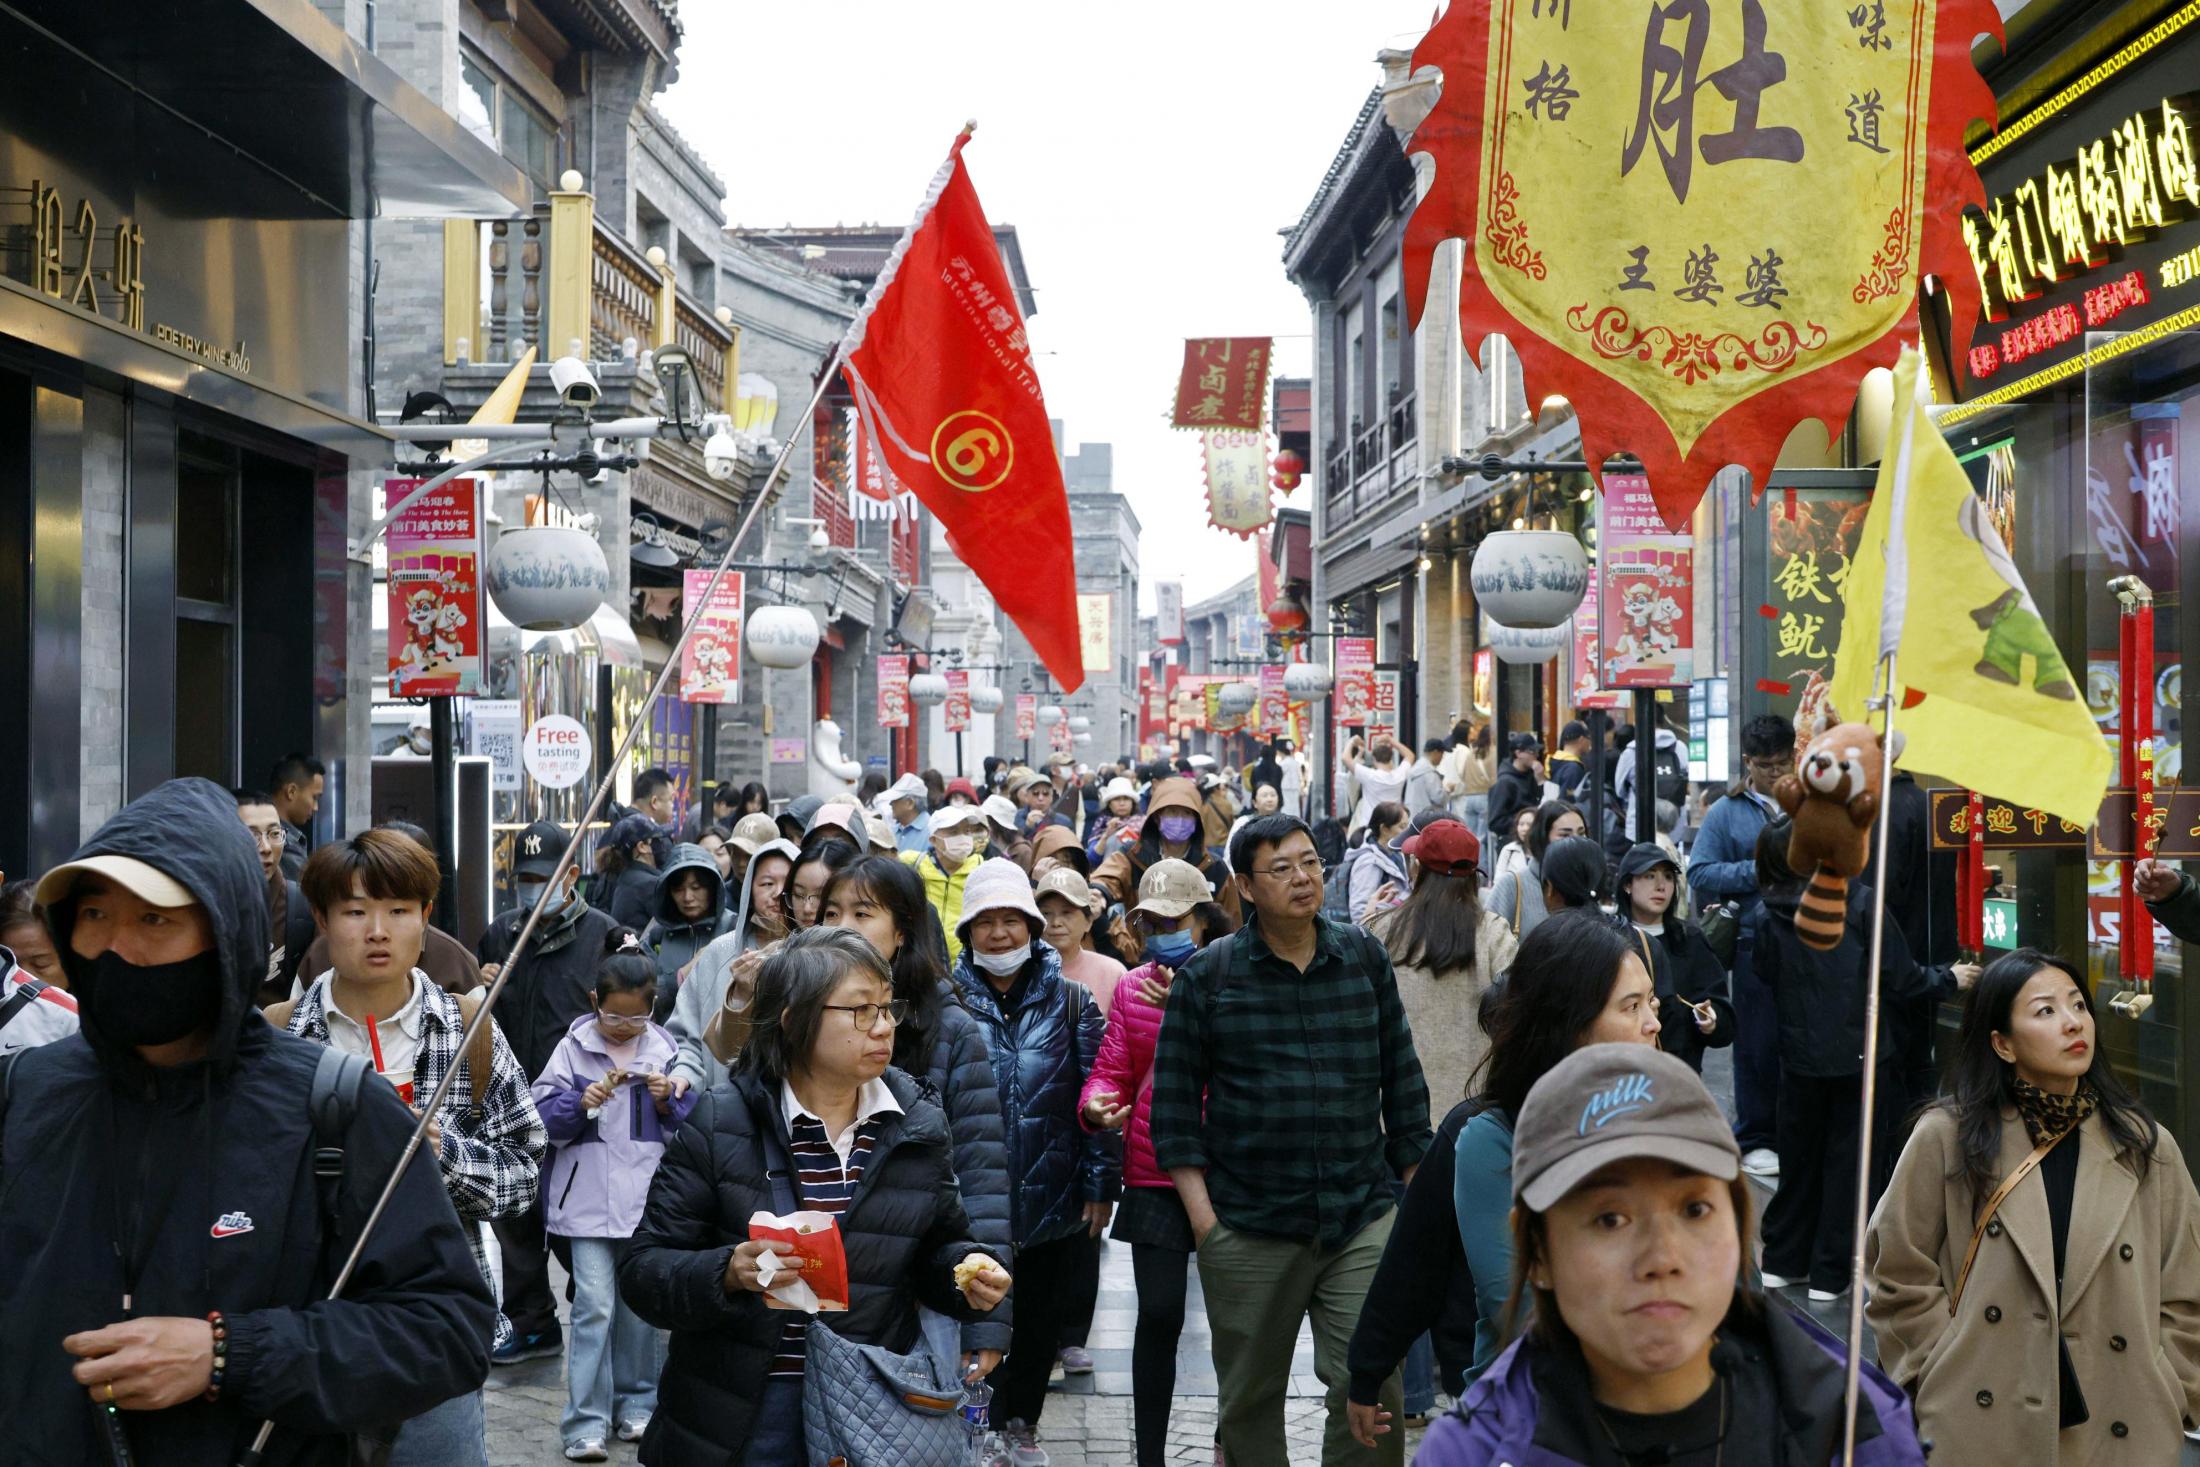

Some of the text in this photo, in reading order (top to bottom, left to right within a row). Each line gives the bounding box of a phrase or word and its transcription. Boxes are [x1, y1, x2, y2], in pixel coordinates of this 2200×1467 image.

[1621, 0, 1805, 205] 肚
[1844, 0, 1892, 154] 味道
[1618, 243, 1790, 310] 王婆婆
[157, 323, 201, 355] POETRY
[203, 341, 226, 365] WINE
[941, 267, 1018, 372] International
[946, 427, 1000, 476] 6
[1776, 611, 1838, 659] 鱿
[537, 727, 579, 744] Free
[538, 746, 580, 760] tasting
[1580, 1074, 1653, 1136] milk
